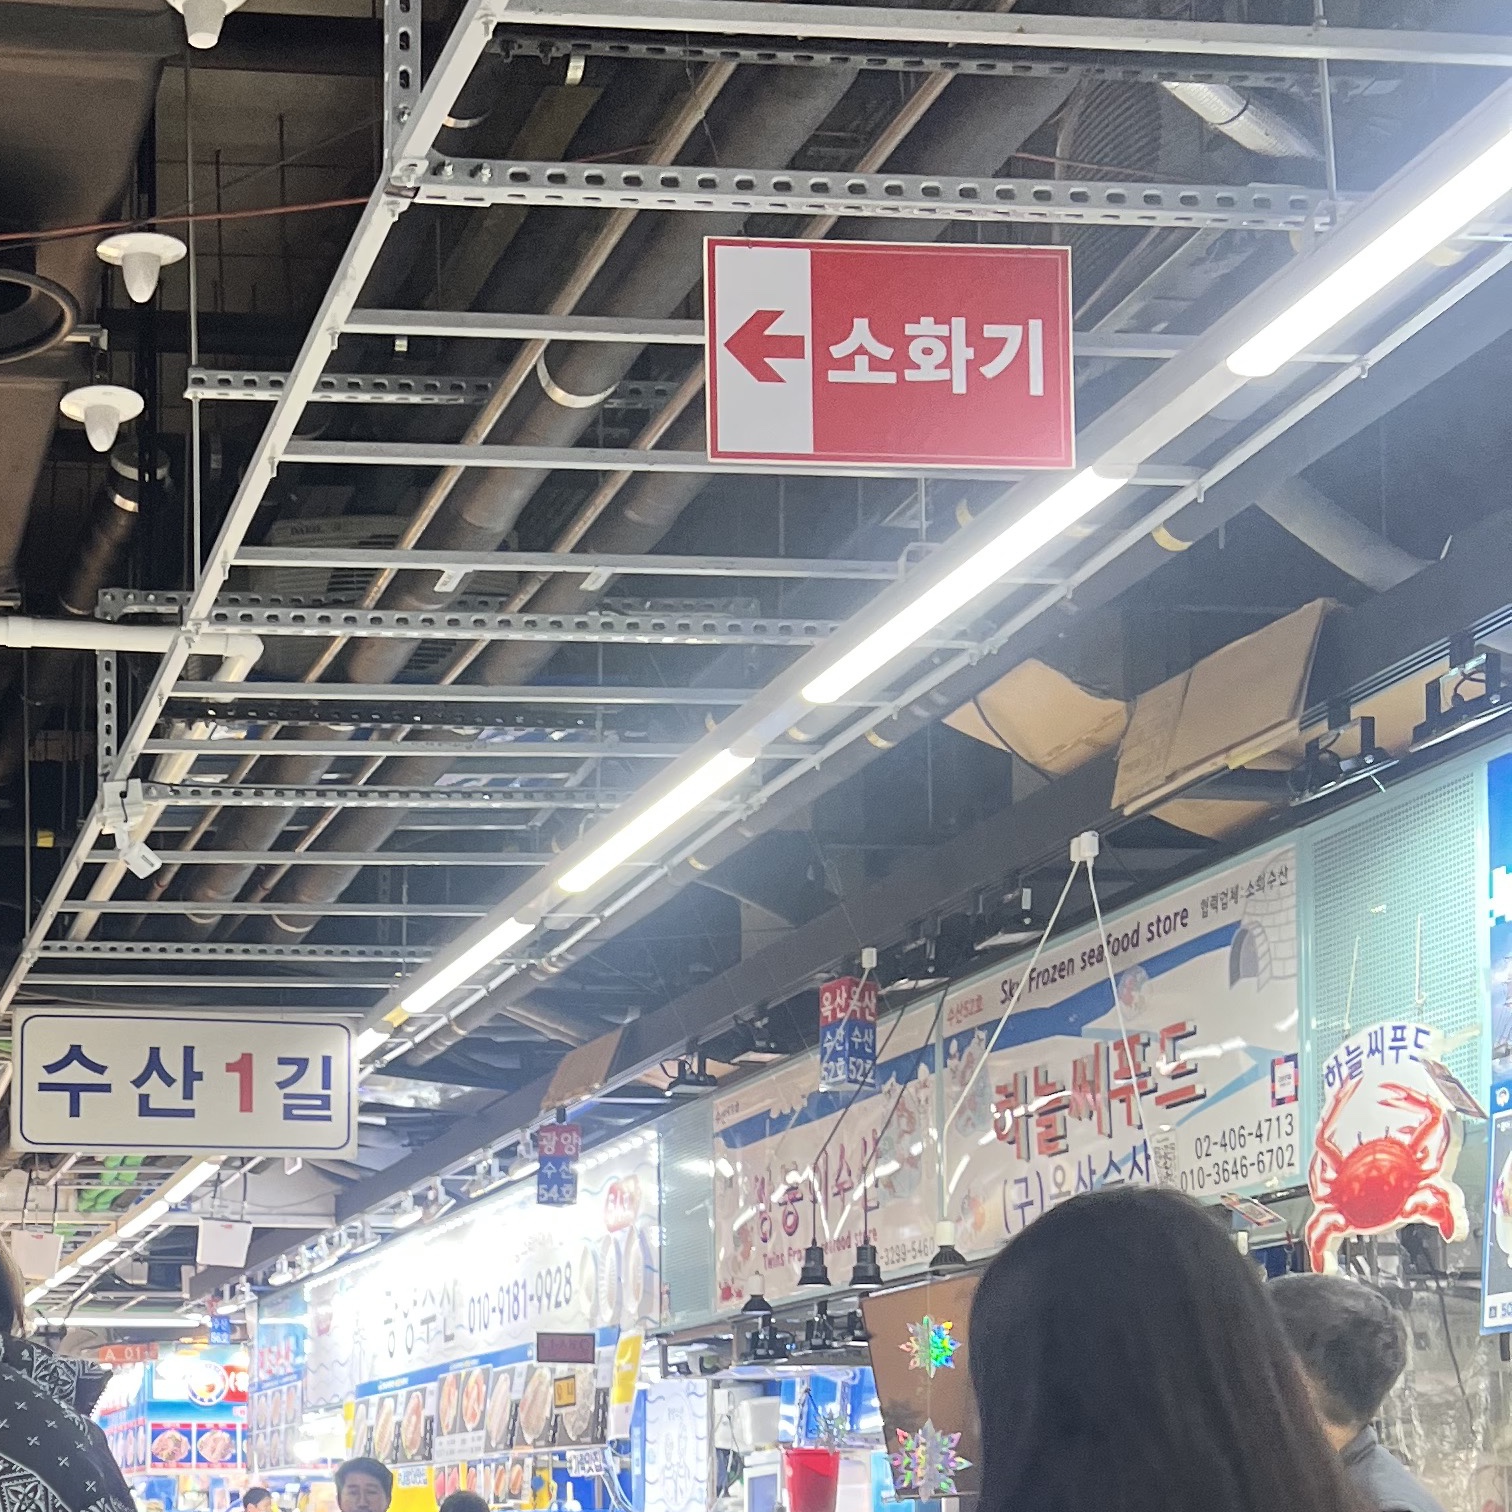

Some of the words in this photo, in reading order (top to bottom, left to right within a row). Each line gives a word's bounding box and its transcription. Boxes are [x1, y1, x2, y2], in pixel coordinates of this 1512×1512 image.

[827, 316, 1045, 397] 소화기
[1027, 957, 1075, 994] Frozen
[1080, 922, 1140, 972] seafood
[1147, 907, 1189, 943] store
[851, 1027, 874, 1054] 수산
[1324, 1024, 1432, 1090] 하늘씨푸드
[37, 1043, 335, 1124] 수산1길
[992, 1021, 1207, 1160] 하늘씨푸드
[539, 1130, 582, 1156] 광양
[1194, 1113, 1295, 1160] 02-406-4713
[541, 1161, 574, 1180] 수산
[1179, 1143, 1296, 1192] 010-3646-6702
[538, 1183, 574, 1203] 54호
[467, 1261, 574, 1335] 010-9181-9928
[105, 1349, 116, 1361] A
